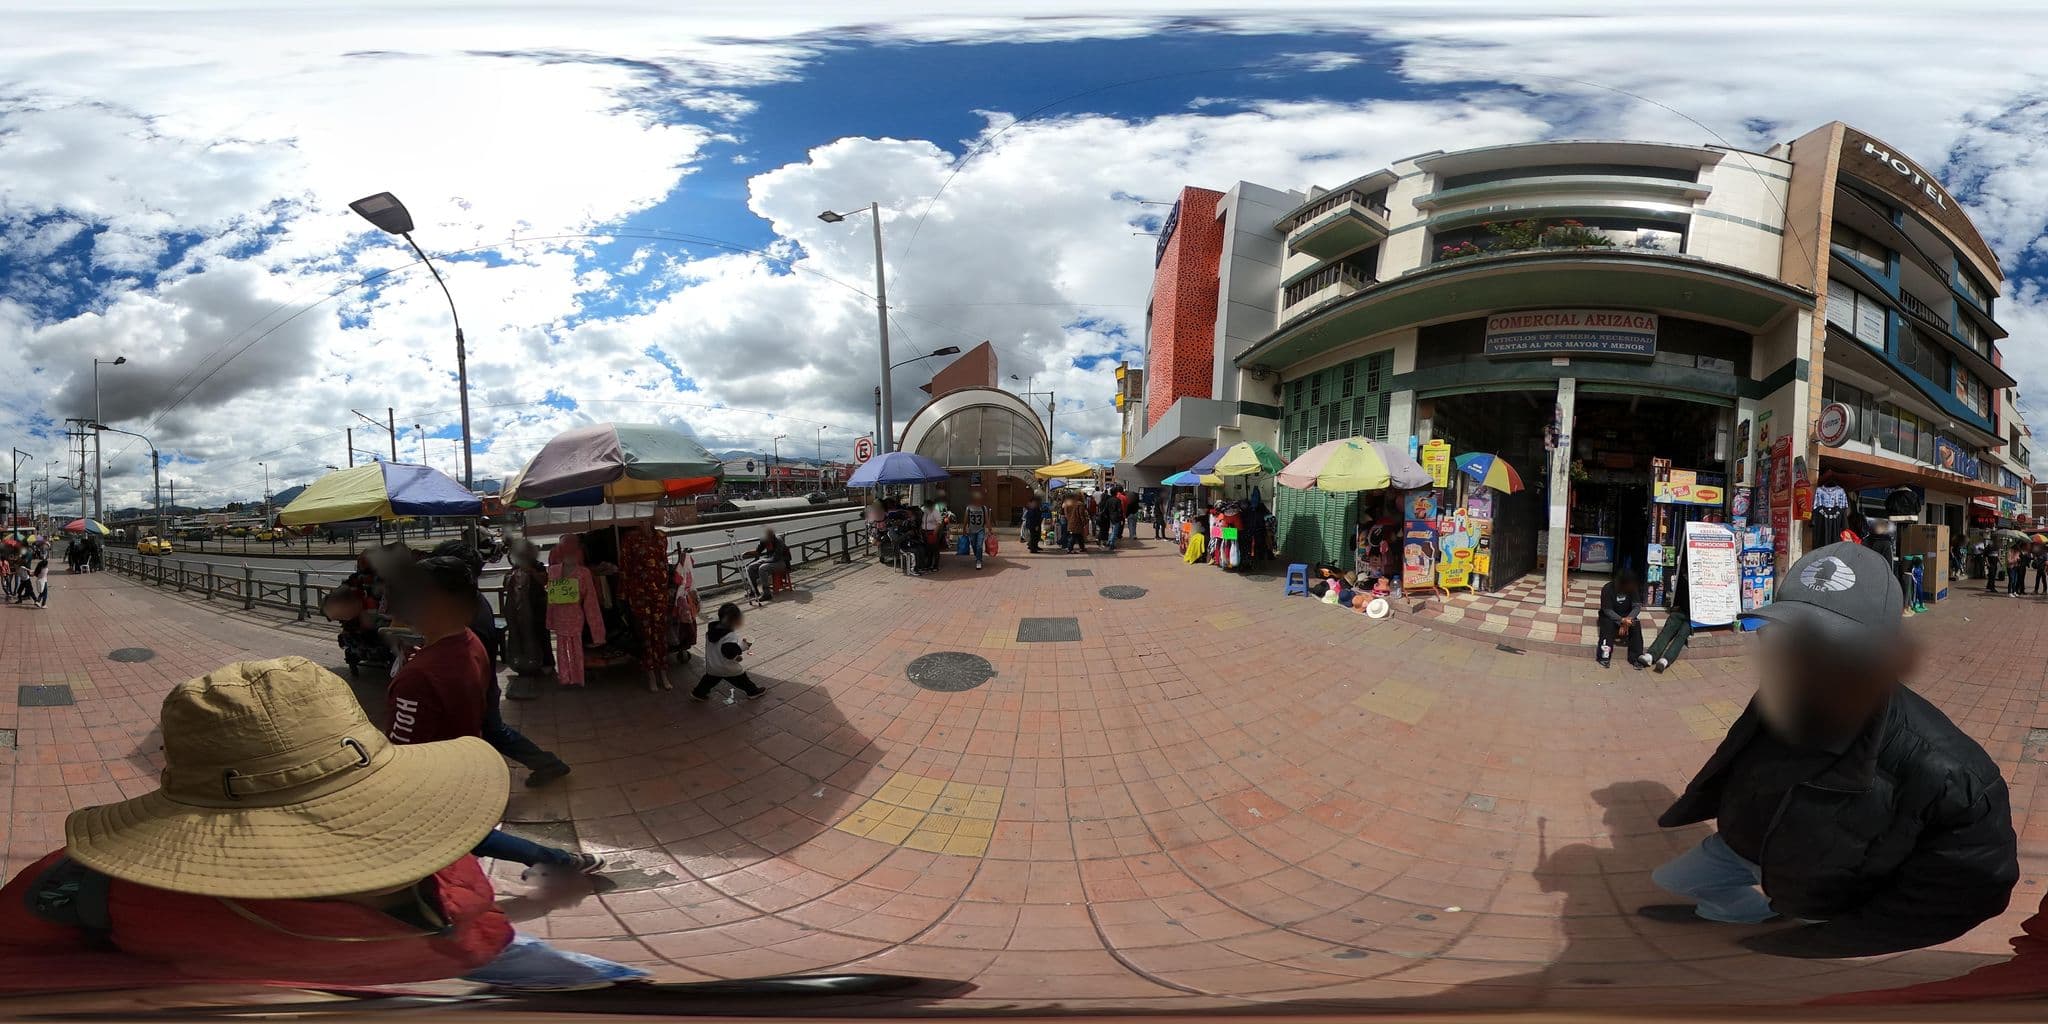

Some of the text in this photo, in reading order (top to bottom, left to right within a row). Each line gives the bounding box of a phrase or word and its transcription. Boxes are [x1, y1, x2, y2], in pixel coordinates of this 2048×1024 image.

[1864, 142, 1947, 211] HOTEL
[1489, 313, 1656, 330] COMERCIAL ARIZAGA
[1554, 333, 1596, 341] PRIMERA
[1599, 334, 1653, 344] NECESIDAD
[1494, 343, 1528, 351] VENTAS
[1610, 342, 1645, 351] MENOR
[859, 443, 868, 459] E
[970, 514, 982, 526] 33
